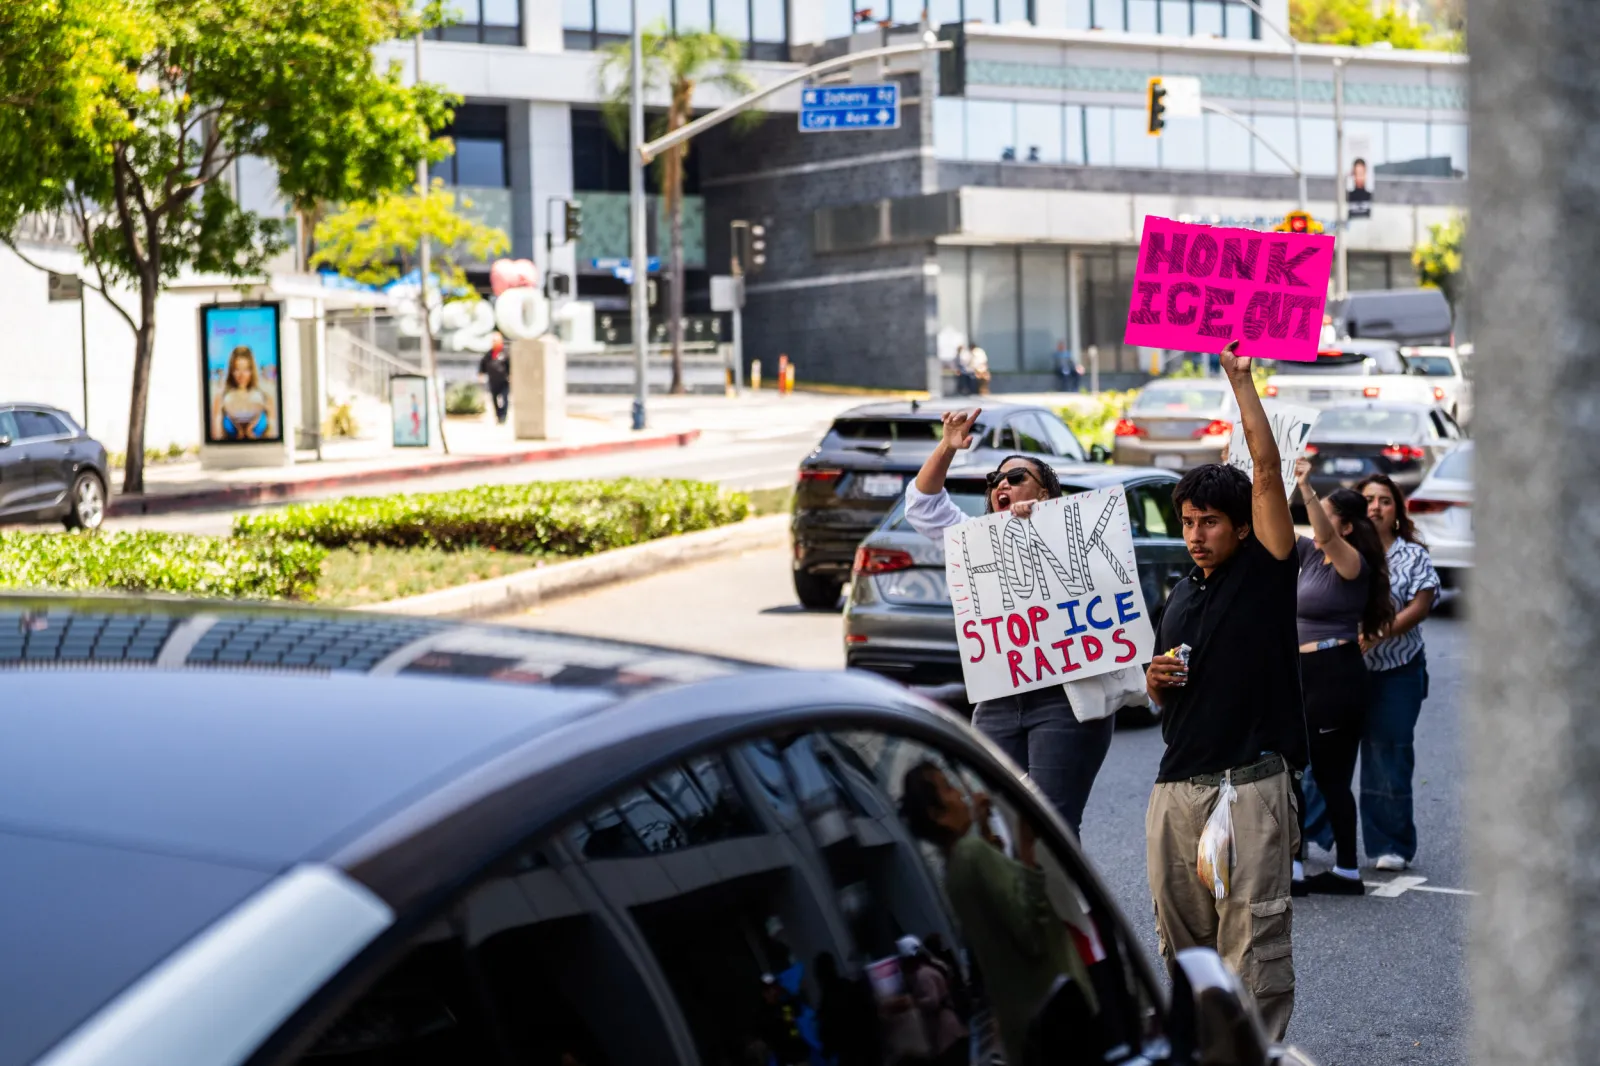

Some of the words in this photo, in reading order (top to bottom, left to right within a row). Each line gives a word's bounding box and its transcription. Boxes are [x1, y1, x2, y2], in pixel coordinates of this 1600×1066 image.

[1144, 232, 1321, 288] HONK
[1130, 281, 1235, 340] ICE
[1243, 290, 1321, 341] OUT
[961, 495, 1132, 617] HONK
[962, 605, 1049, 663] STOP
[1056, 590, 1141, 637] ICE
[1006, 628, 1137, 688] RAIDS
